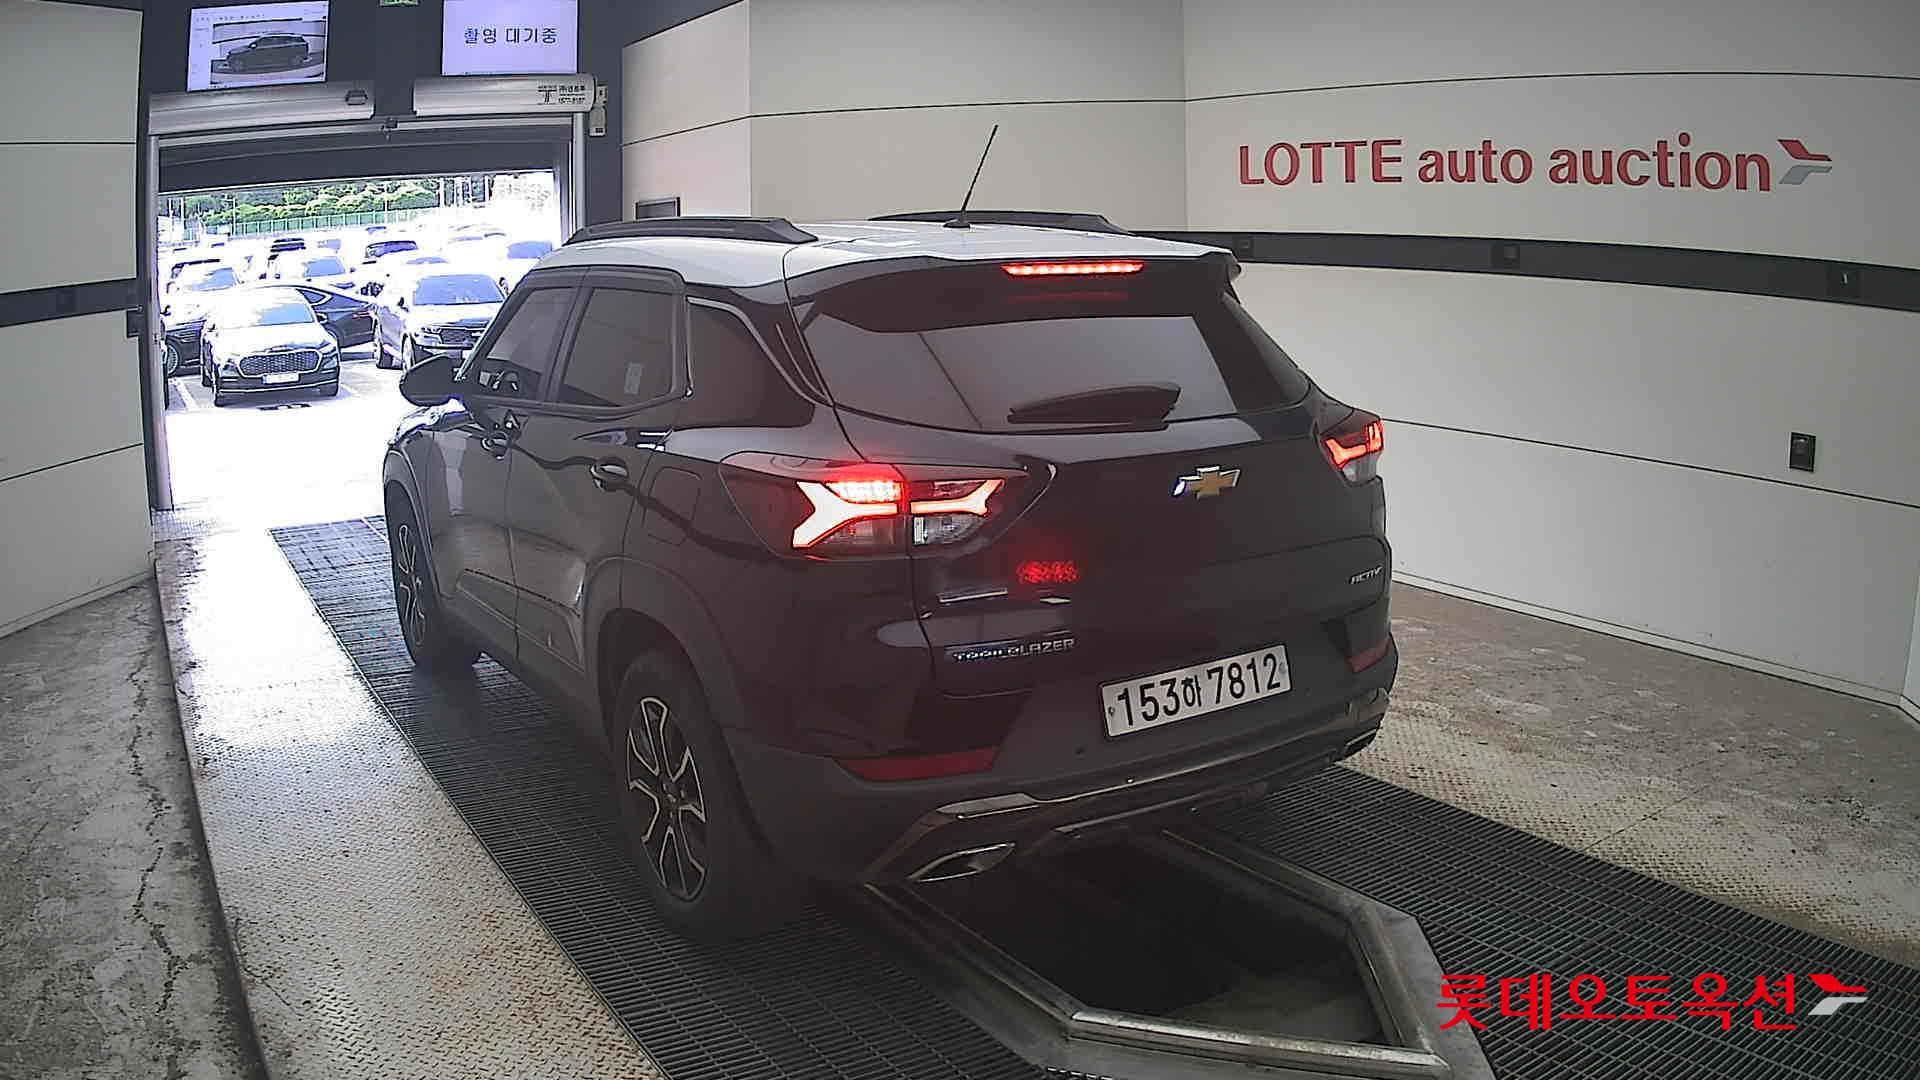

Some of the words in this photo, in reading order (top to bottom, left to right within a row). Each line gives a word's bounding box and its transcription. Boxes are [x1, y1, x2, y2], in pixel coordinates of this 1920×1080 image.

[464, 27, 497, 44] 촬영
[505, 27, 557, 44] 대기중
[1238, 139, 1402, 186] LOTTE
[1417, 139, 1533, 185] auto
[1548, 132, 1772, 191] auction
[1206, 653, 1281, 705] 7812
